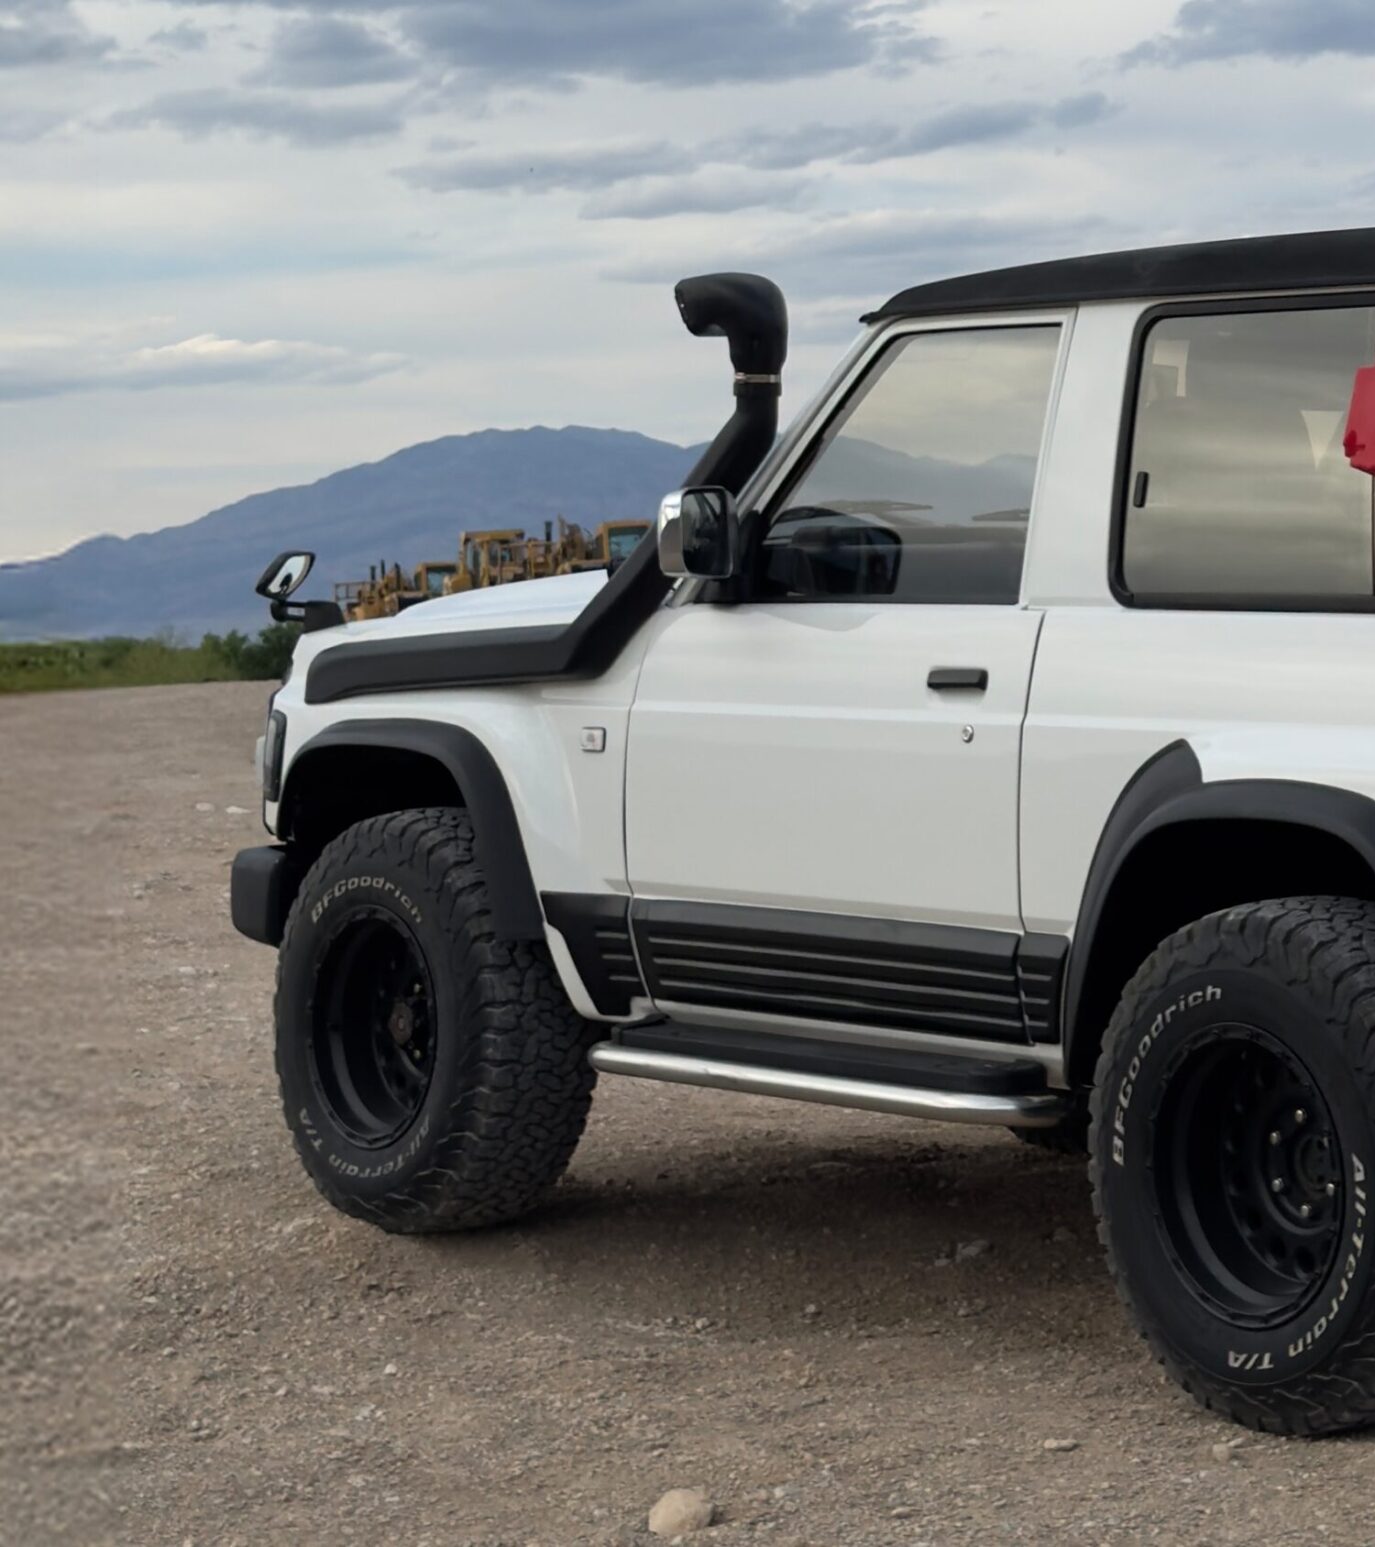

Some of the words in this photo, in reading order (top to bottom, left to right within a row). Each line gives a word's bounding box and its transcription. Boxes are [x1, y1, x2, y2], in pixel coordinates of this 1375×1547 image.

[311, 876, 423, 925] BFGoodrich
[1112, 985, 1222, 1167] BFGoodrich
[1287, 1153, 1367, 1359] All-Terrain
[1227, 1349, 1275, 1370] T/A
